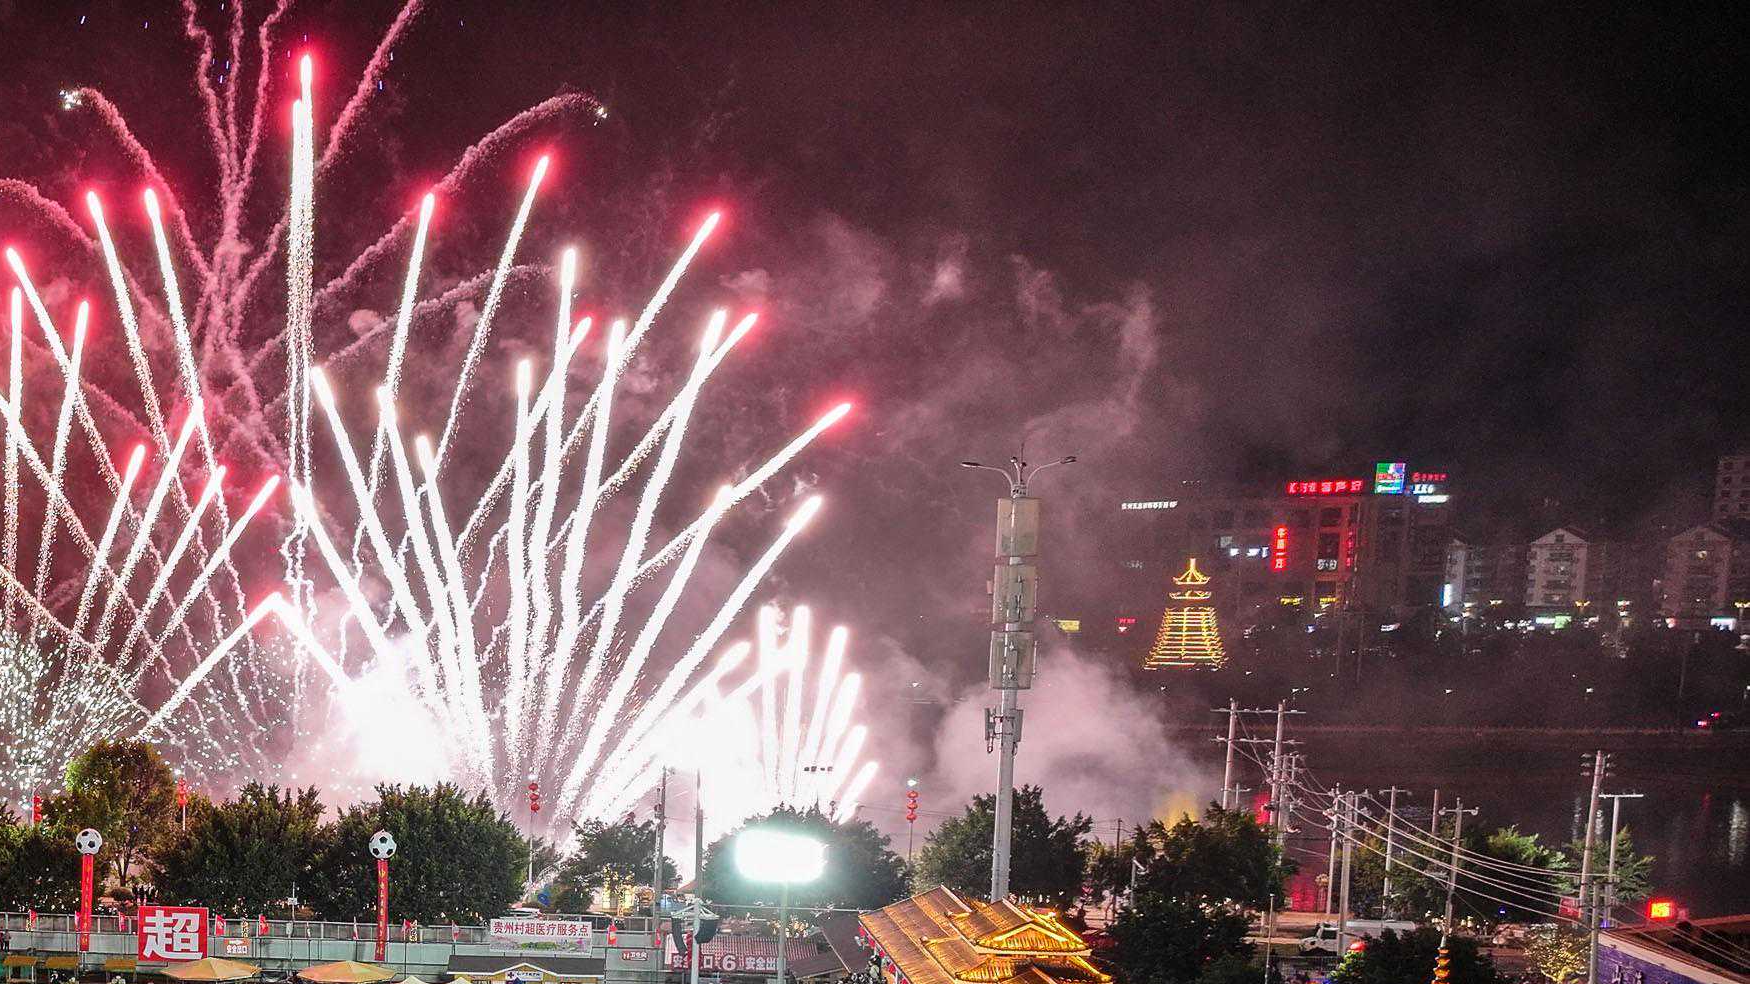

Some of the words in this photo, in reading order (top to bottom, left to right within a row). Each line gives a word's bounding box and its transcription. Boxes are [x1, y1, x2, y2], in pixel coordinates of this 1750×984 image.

[143, 909, 201, 960] 超
[493, 921, 589, 937] 贵州村超医疗服务点
[722, 955, 736, 971] 6
[746, 956, 778, 970] 安全出
